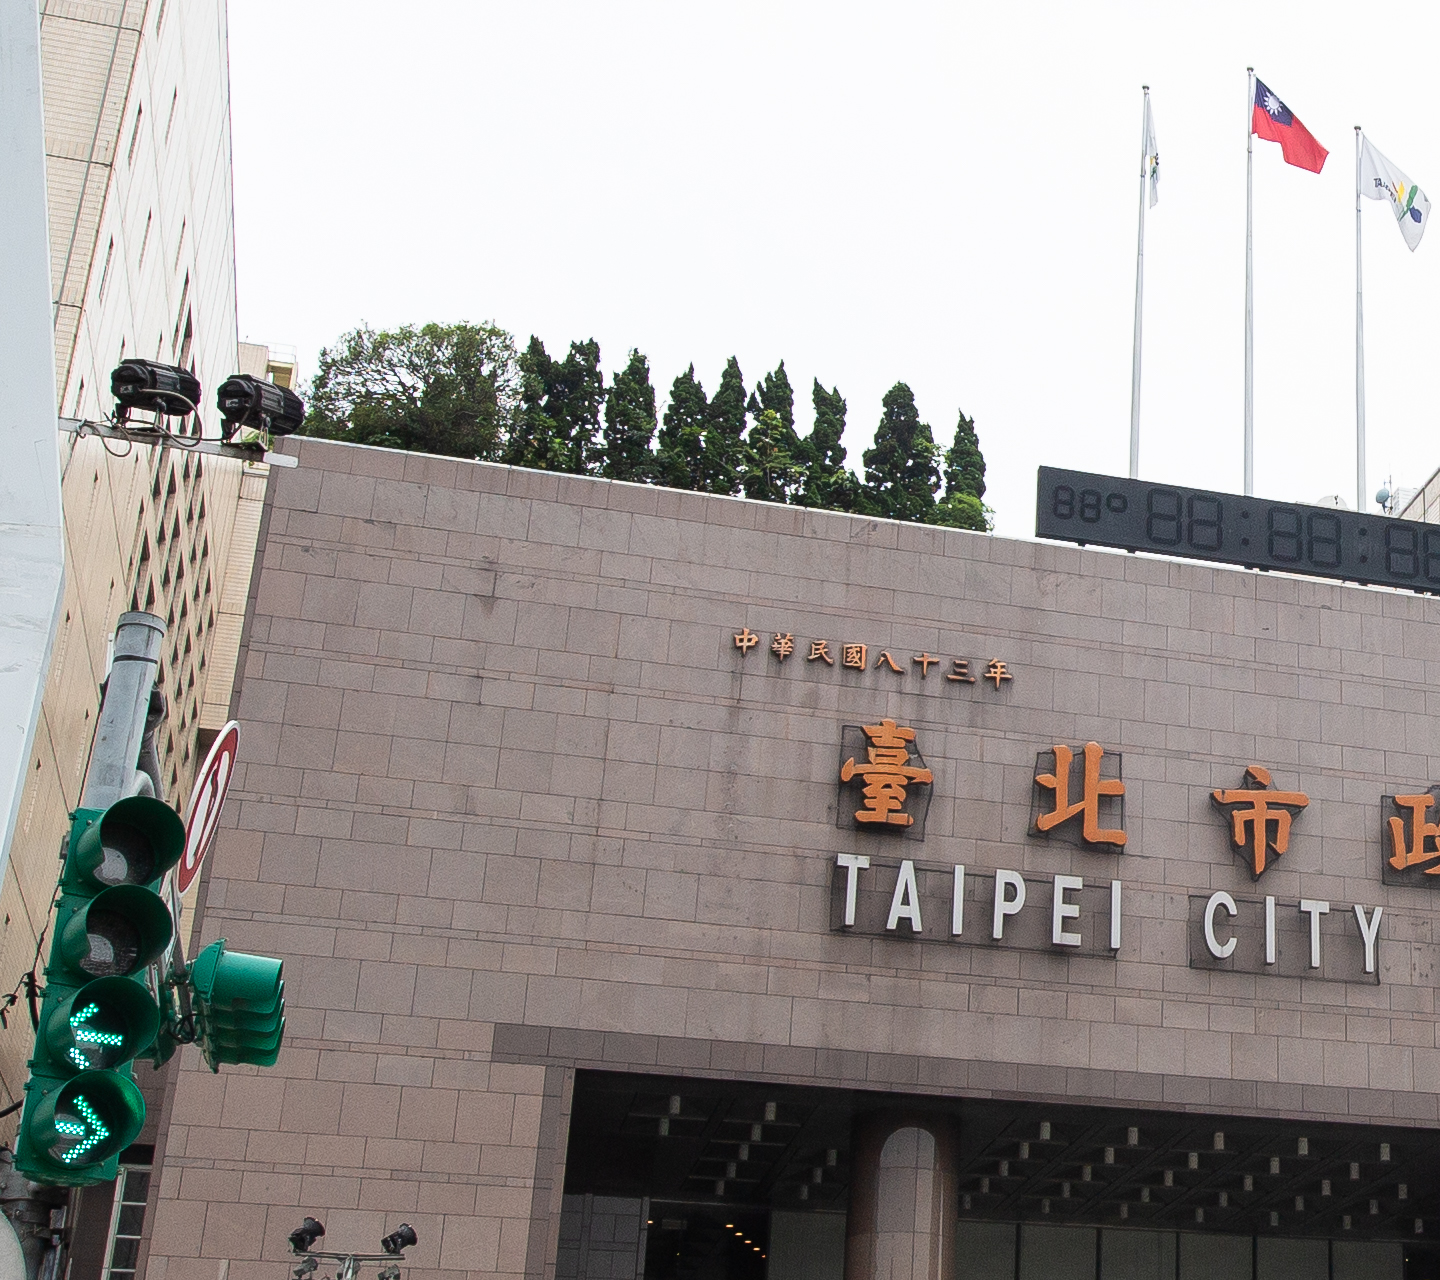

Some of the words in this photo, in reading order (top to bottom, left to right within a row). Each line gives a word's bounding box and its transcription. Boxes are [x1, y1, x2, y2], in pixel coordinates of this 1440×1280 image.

[732, 626, 1014, 691] 中華民國八十三年
[835, 852, 1123, 951] TAIPEI
[1203, 890, 1384, 975] CITY
